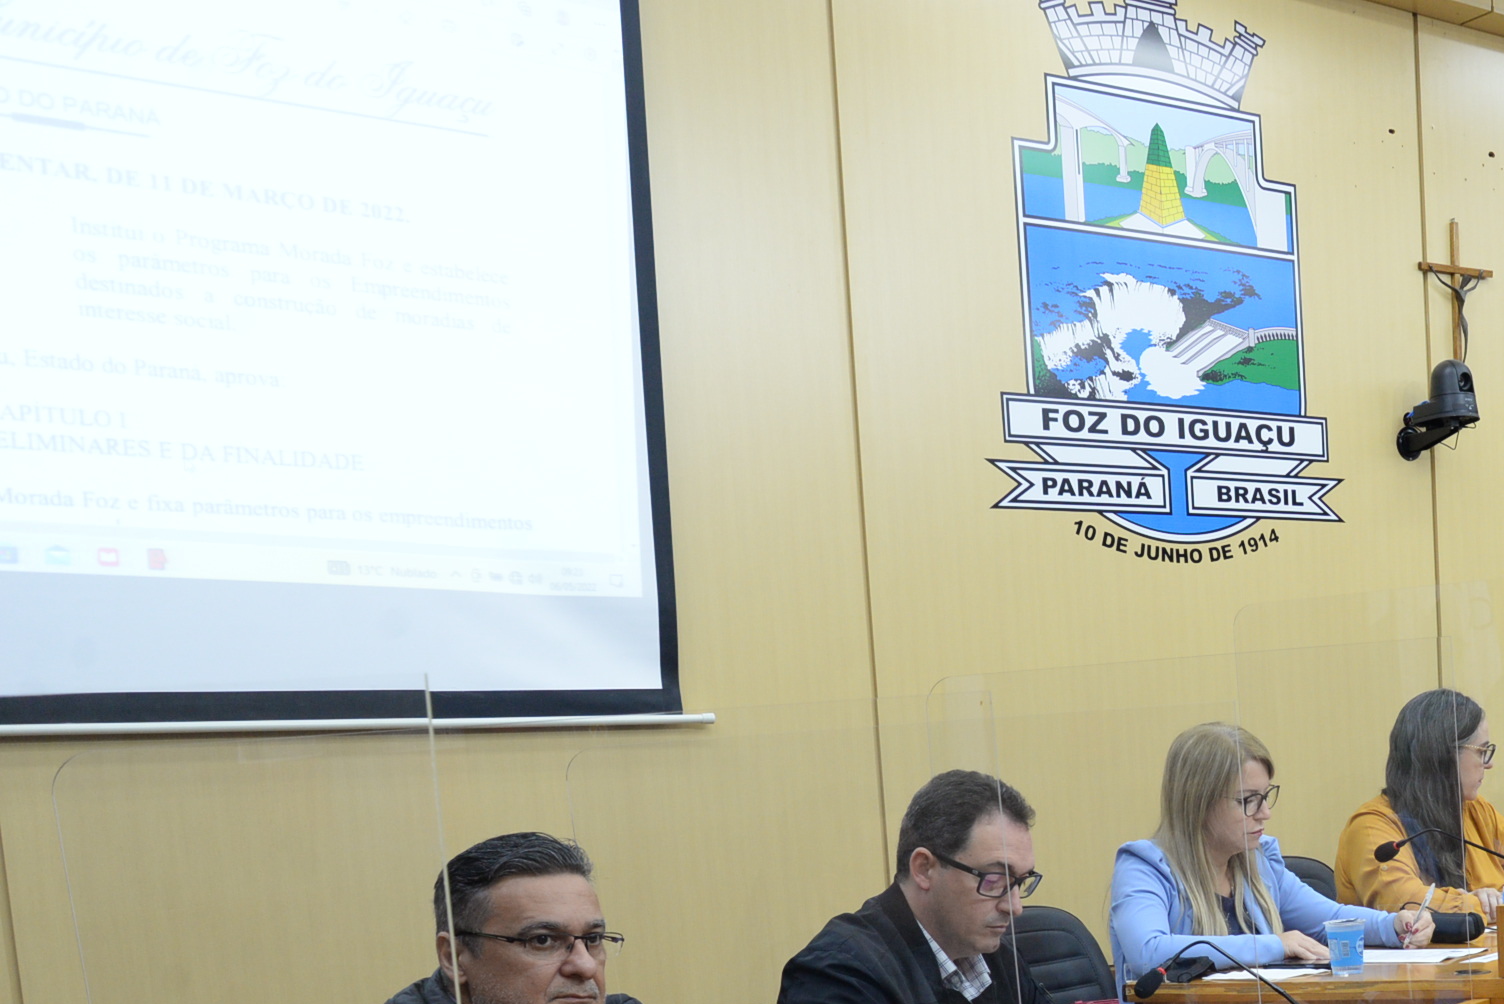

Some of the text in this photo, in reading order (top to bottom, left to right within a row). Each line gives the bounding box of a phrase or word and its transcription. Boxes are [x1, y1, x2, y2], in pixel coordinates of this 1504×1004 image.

[155, 28, 495, 122] de Foz do Iguaçu
[17, 89, 55, 111] DO
[106, 167, 140, 188] DE
[149, 173, 172, 192] 11
[181, 177, 214, 198] DE
[221, 182, 315, 211] MARÇO
[323, 195, 353, 217] DE
[73, 247, 98, 264] os
[117, 251, 230, 279] parâmetros
[250, 266, 291, 286] para
[310, 274, 332, 289] os
[175, 228, 271, 256] Programa
[278, 241, 352, 267] Morada
[361, 250, 394, 272] Foz
[419, 262, 511, 286] estabelece
[74, 271, 184, 300] destinados
[233, 291, 337, 317] construção
[355, 302, 377, 321] de
[395, 306, 475, 332] moradias
[78, 300, 167, 326] interesse
[23, 347, 94, 373] Estado
[102, 354, 127, 375] do
[1041, 407, 1295, 451] FOZ DO IGUAÇU
[159, 441, 173, 460] E
[181, 442, 216, 464] DA
[222, 445, 365, 472] FINALIDADE
[1042, 476, 1152, 500] PARANÁ
[1217, 485, 1304, 507] BRASIL
[81, 491, 535, 532] Foz e fixa parâmetros para os empreendimentos
[1074, 520, 1280, 564] 10 DE JUNHO DE 1914
